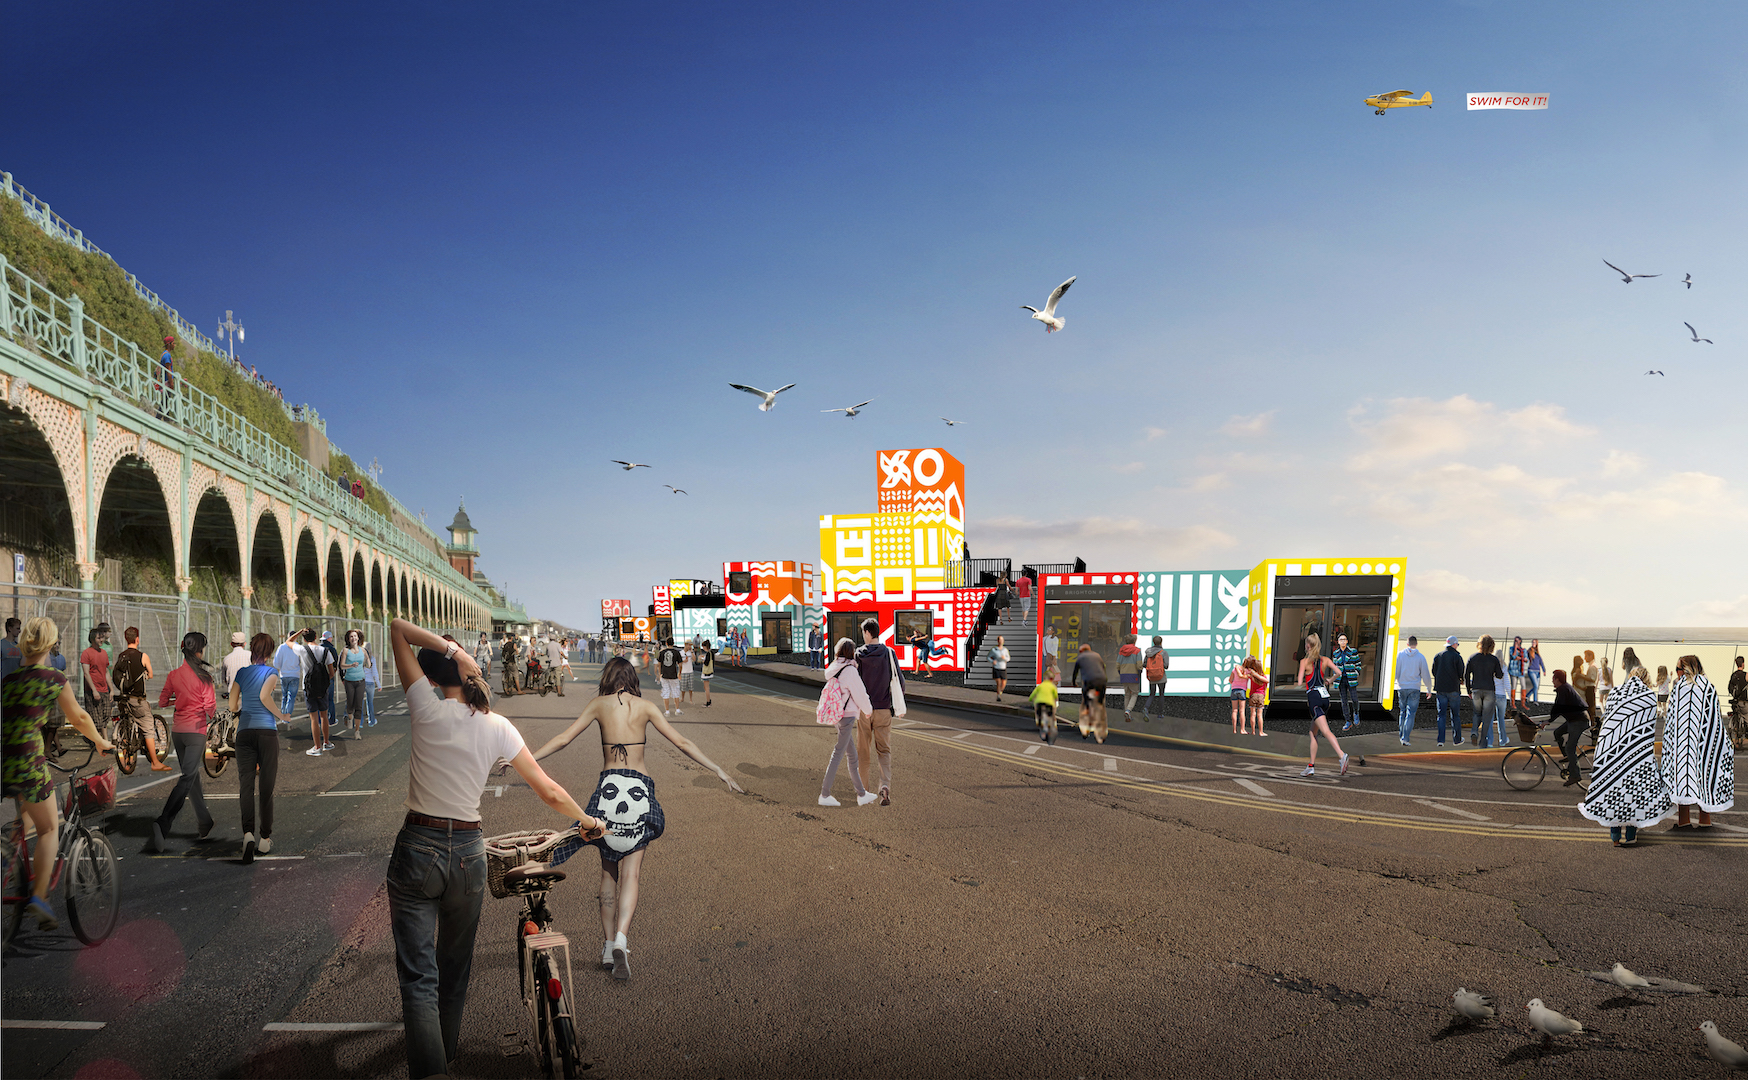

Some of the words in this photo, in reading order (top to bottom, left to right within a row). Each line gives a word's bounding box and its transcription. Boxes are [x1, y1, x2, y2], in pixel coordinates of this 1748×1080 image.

[1469, 97, 1502, 106] SWIM
[1505, 97, 1530, 106] FOR
[1533, 97, 1547, 106] IT!
[17, 556, 23, 570] P
[1067, 615, 1080, 663] OPEN
